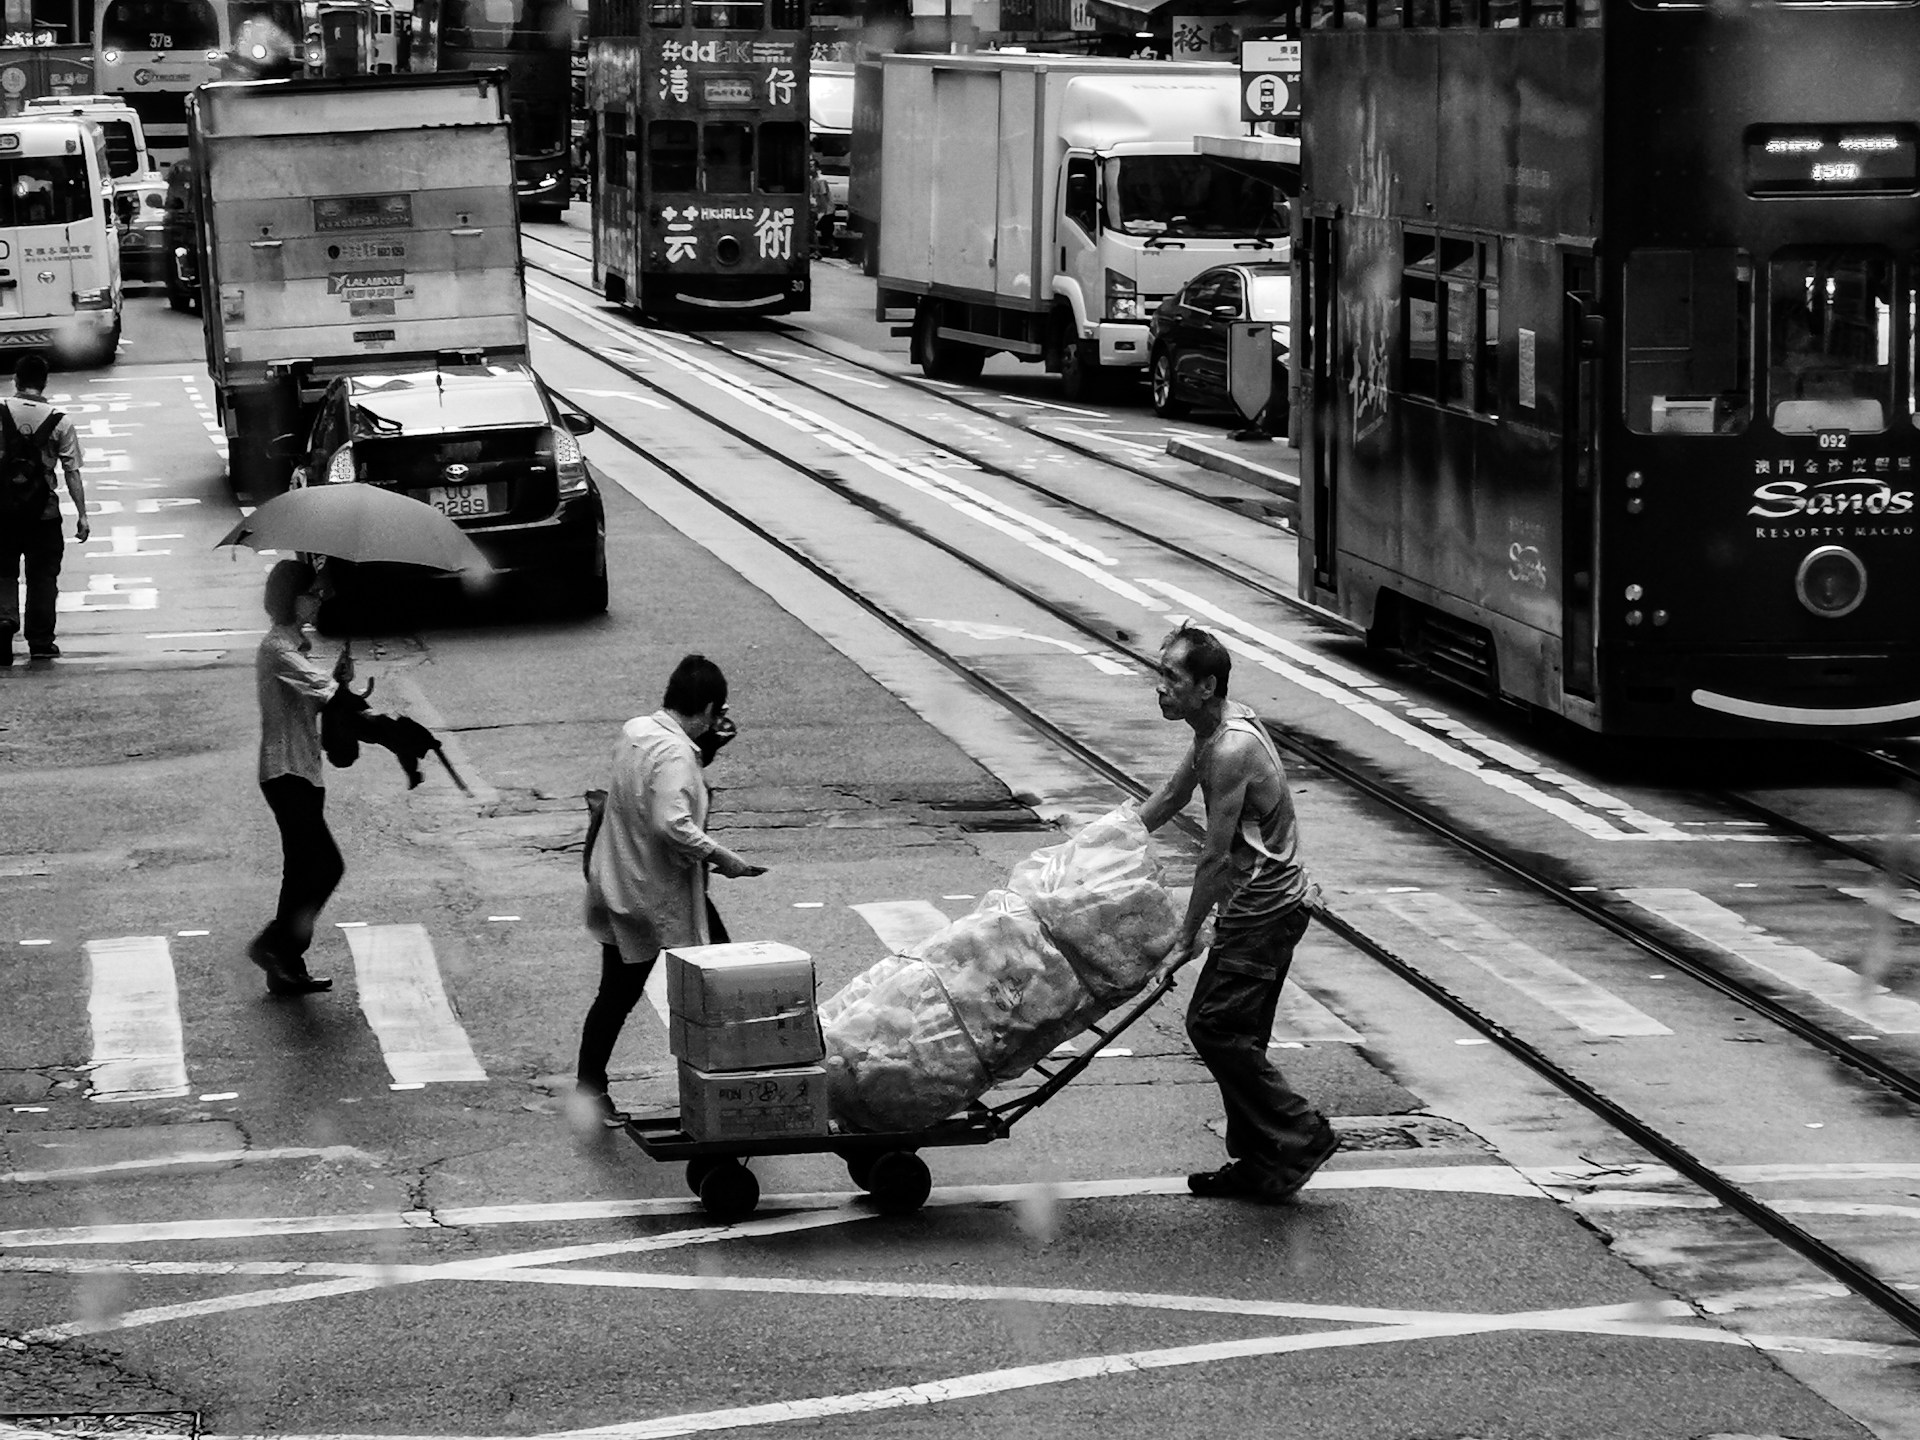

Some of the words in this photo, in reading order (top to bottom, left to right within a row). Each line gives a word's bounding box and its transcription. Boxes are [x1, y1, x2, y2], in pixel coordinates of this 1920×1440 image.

[149, 33, 173, 48] 37B
[700, 207, 755, 221] HKWALLS
[346, 275, 402, 287] LALAMOVE
[791, 279, 805, 293] 30
[1819, 434, 1847, 448] 092
[1747, 478, 1914, 518] Sands
[1755, 527, 1845, 538] RESORTS
[1854, 526, 1914, 537] MACAO
